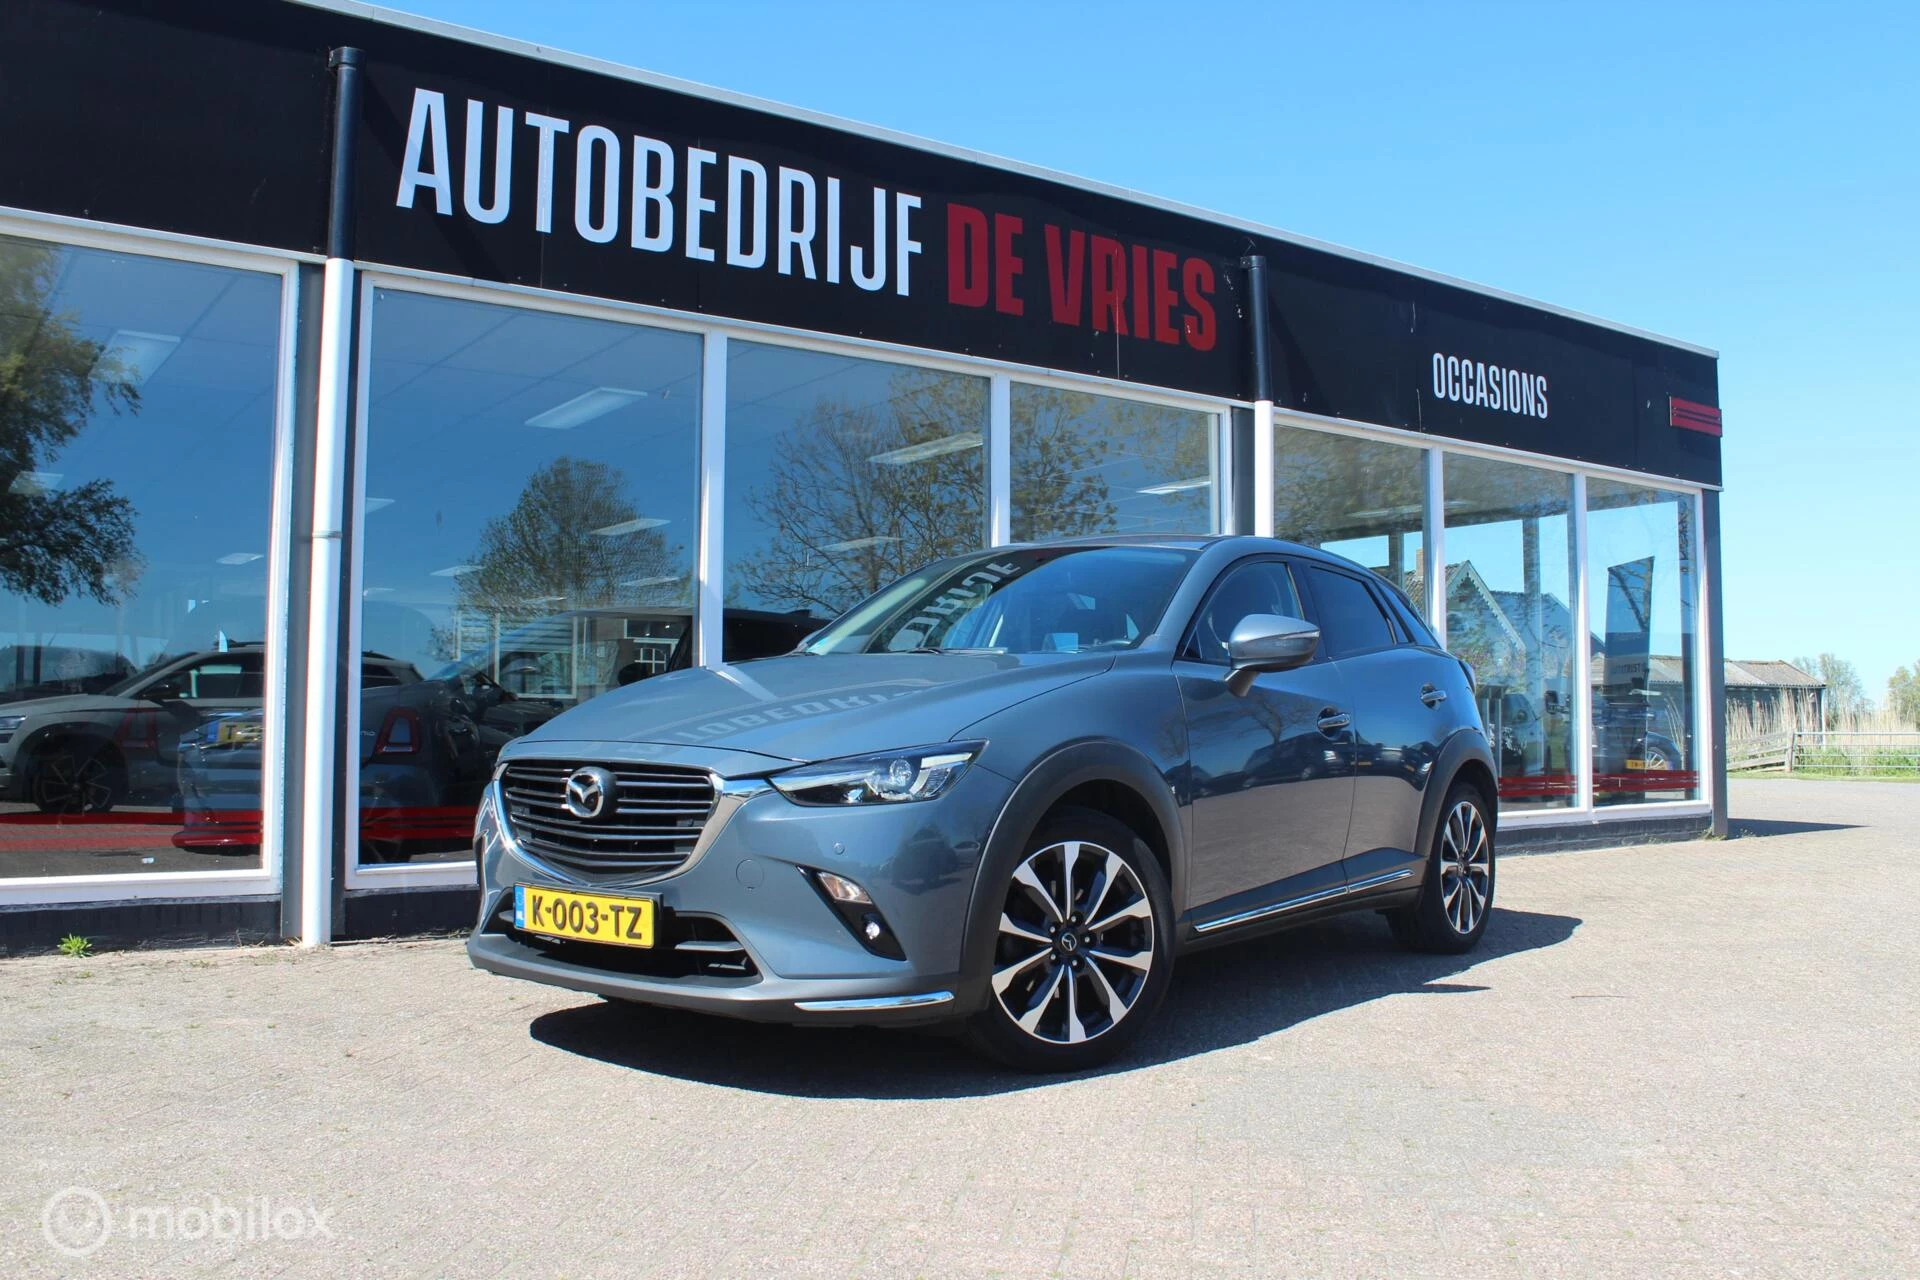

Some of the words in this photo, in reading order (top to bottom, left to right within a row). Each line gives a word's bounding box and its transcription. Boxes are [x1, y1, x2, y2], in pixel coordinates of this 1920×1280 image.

[396, 88, 921, 297] AUTOBEDRIJF
[947, 202, 1024, 316] DE
[1044, 223, 1216, 351] VRIES
[1432, 352, 1548, 419] OCCASIONS
[532, 894, 643, 940] K-003-TZ
